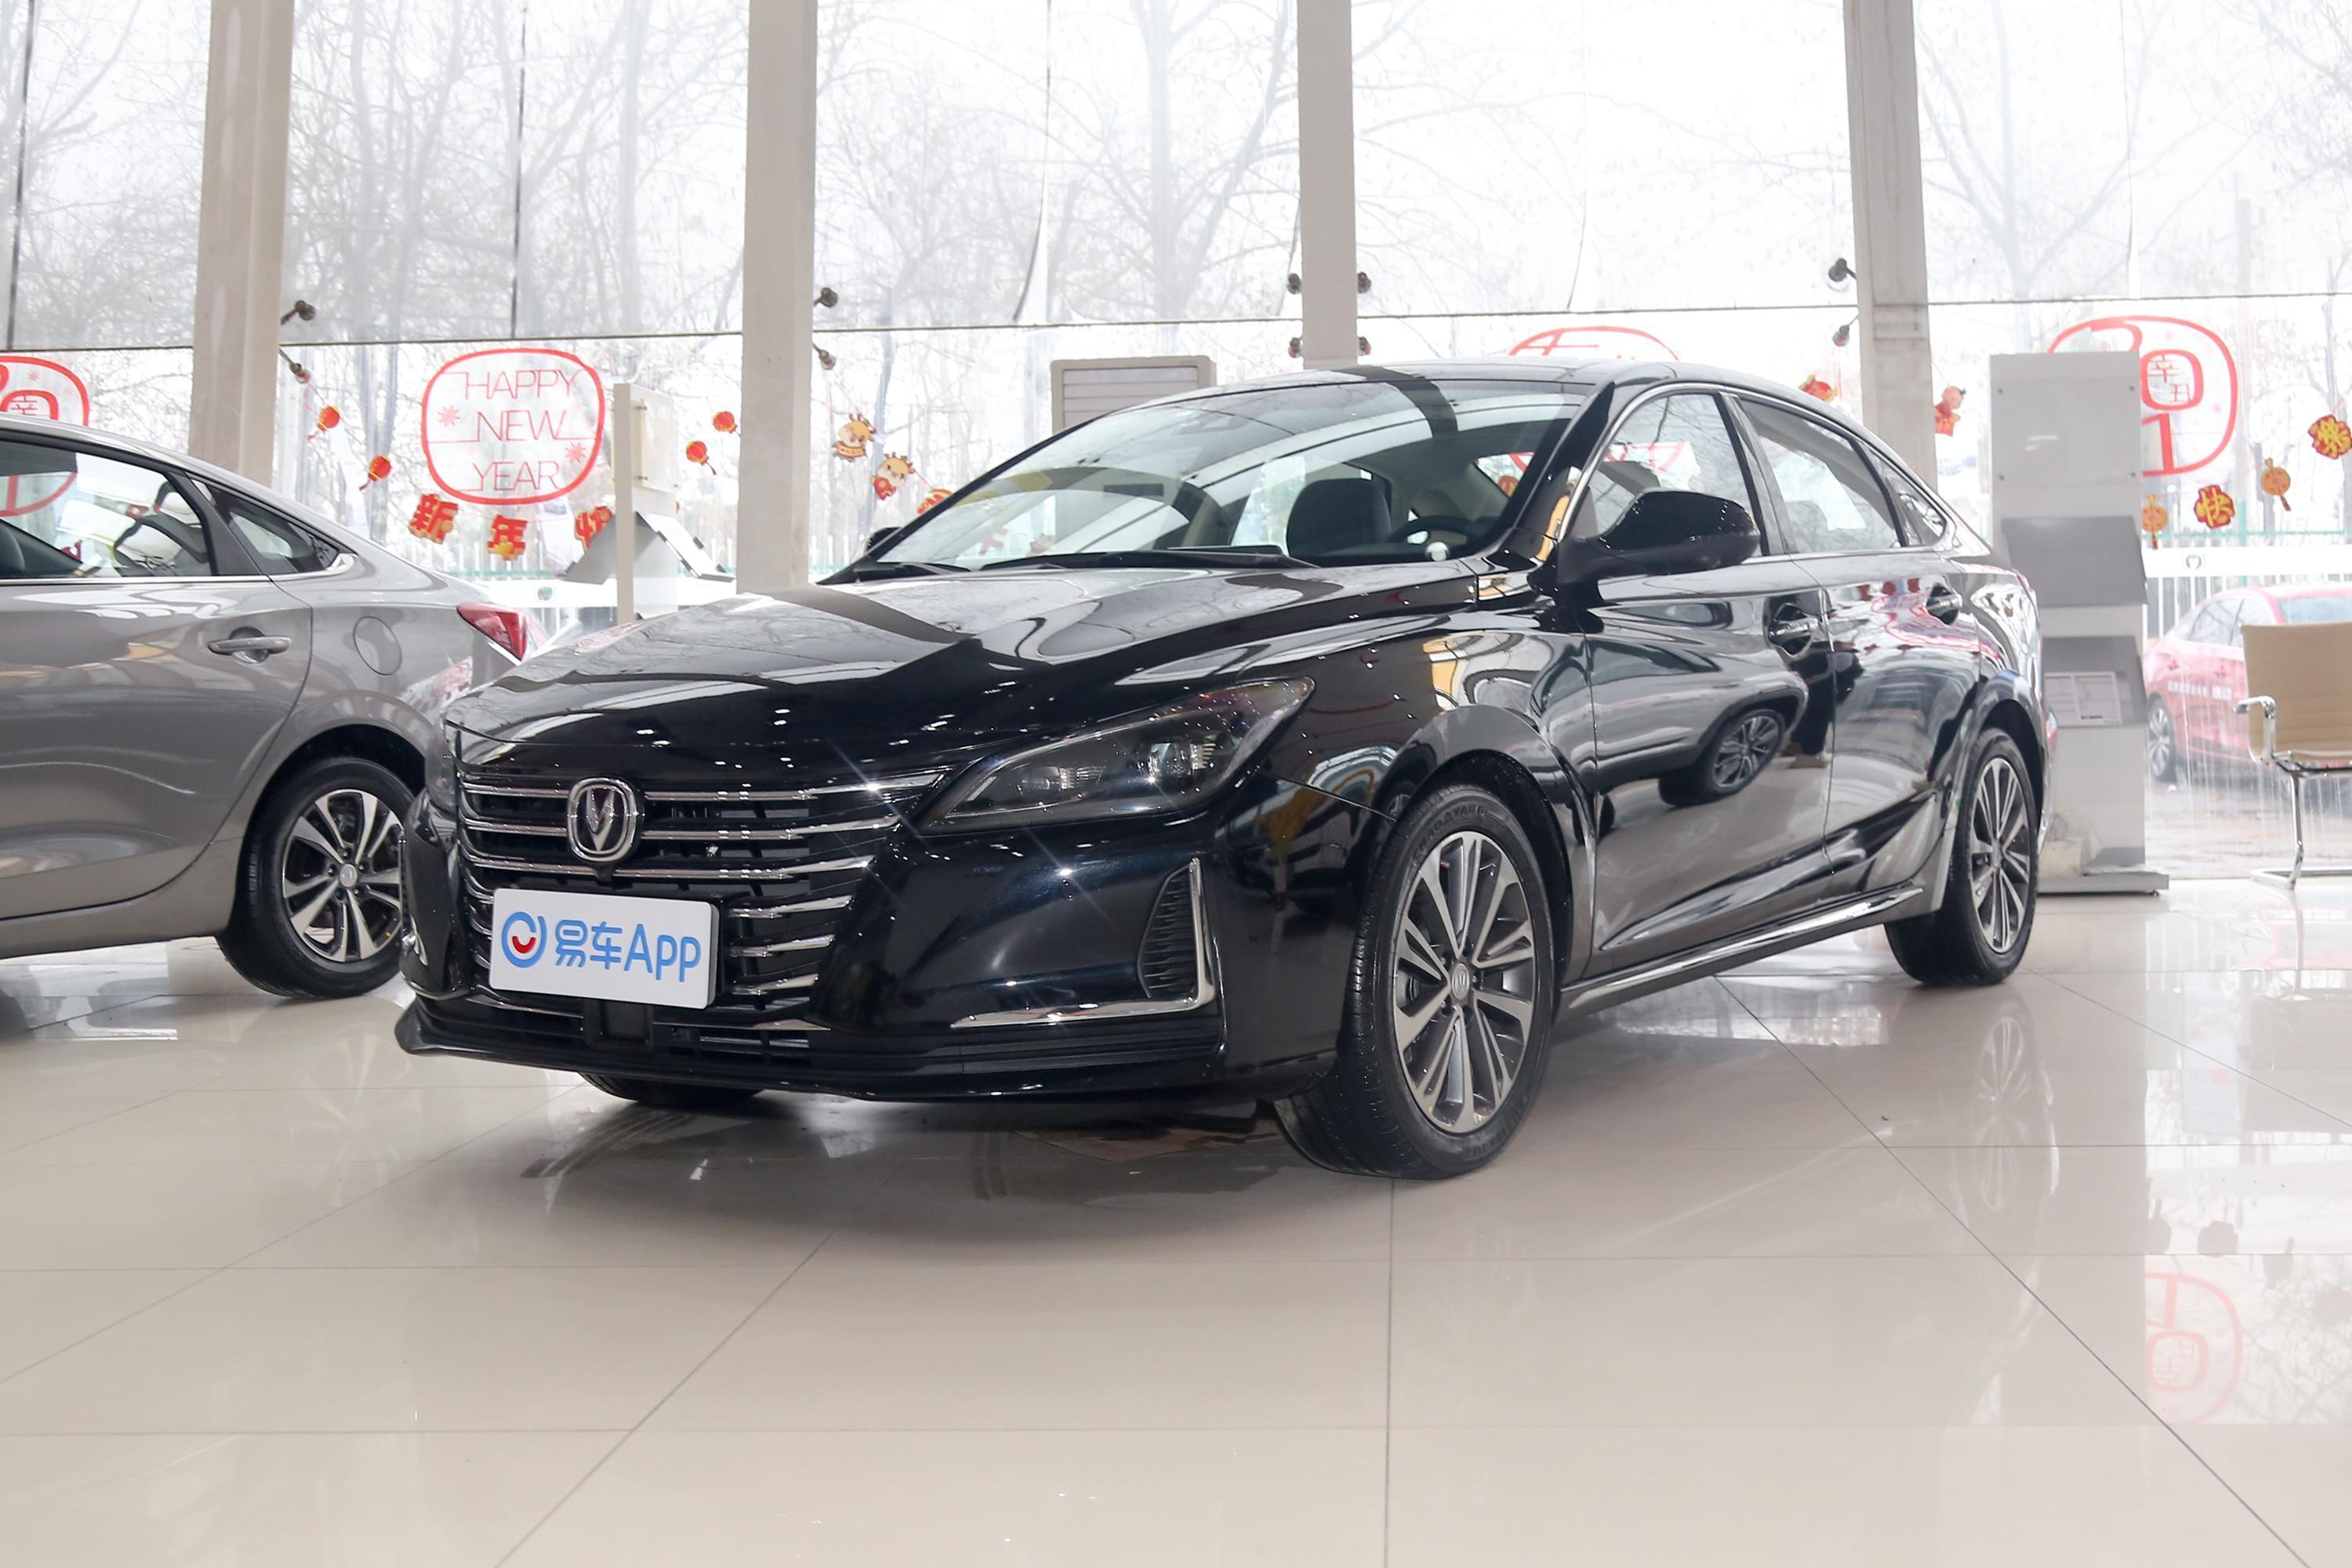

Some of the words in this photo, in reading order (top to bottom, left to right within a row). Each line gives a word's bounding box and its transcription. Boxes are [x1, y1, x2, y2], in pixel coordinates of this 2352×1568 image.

[464, 368, 583, 401] HAPPY
[476, 408, 568, 443] NEW
[472, 460, 562, 492] YEAR
[555, 920, 702, 983] 易车App
